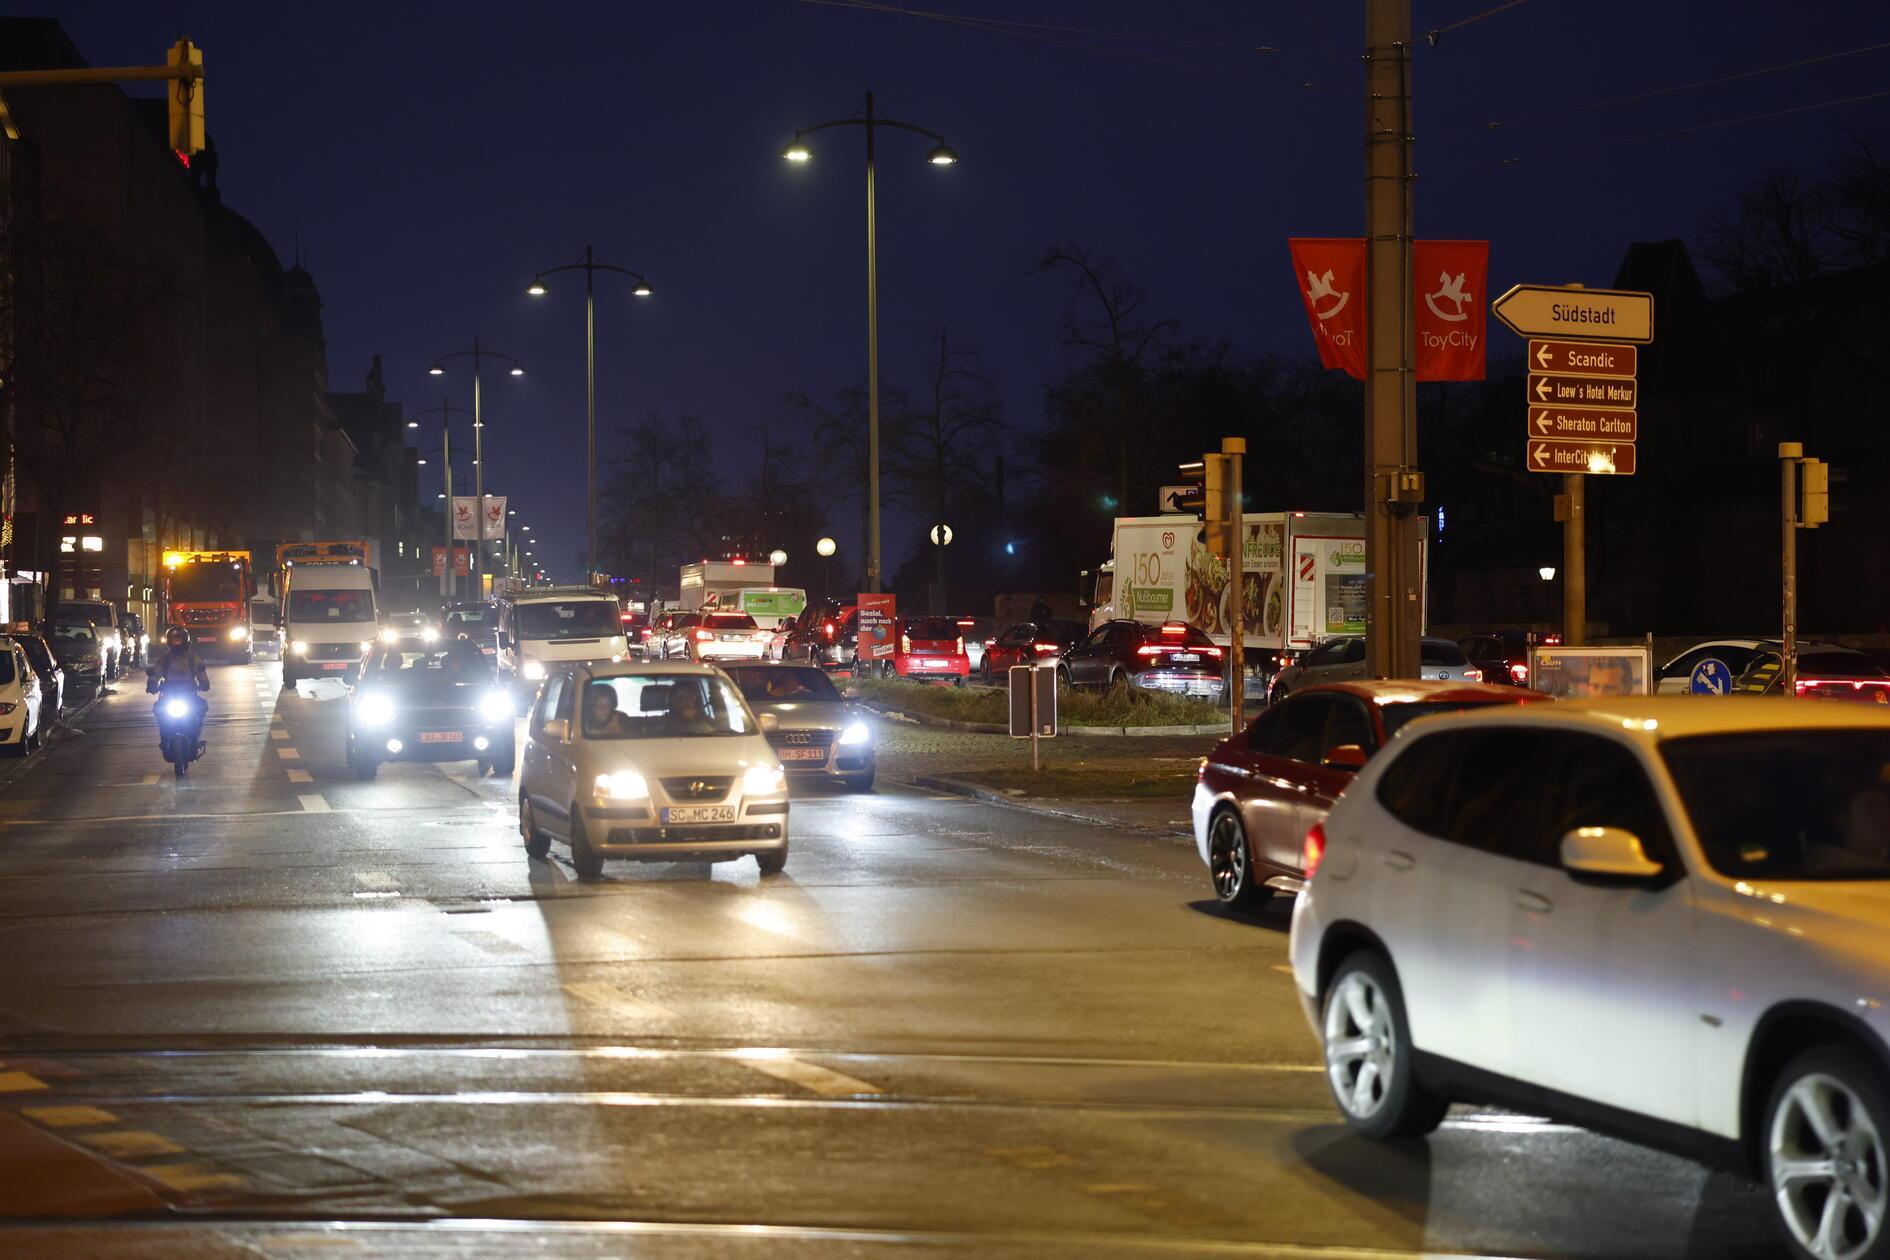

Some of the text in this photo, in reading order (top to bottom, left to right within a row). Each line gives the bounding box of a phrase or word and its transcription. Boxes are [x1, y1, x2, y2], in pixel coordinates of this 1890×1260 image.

[1552, 303, 1615, 325] Südstadt
[1422, 330, 1477, 351] ToyCity
[1568, 350, 1615, 368] Scandic
[1586, 384, 1605, 400] Hotel
[1608, 385, 1633, 401] Merkur
[1556, 415, 1631, 433] Sheraton Carlton
[1554, 448, 1615, 468] InterCitytel
[1133, 552, 1160, 586] 150
[670, 808, 733, 821] SC MC 246
